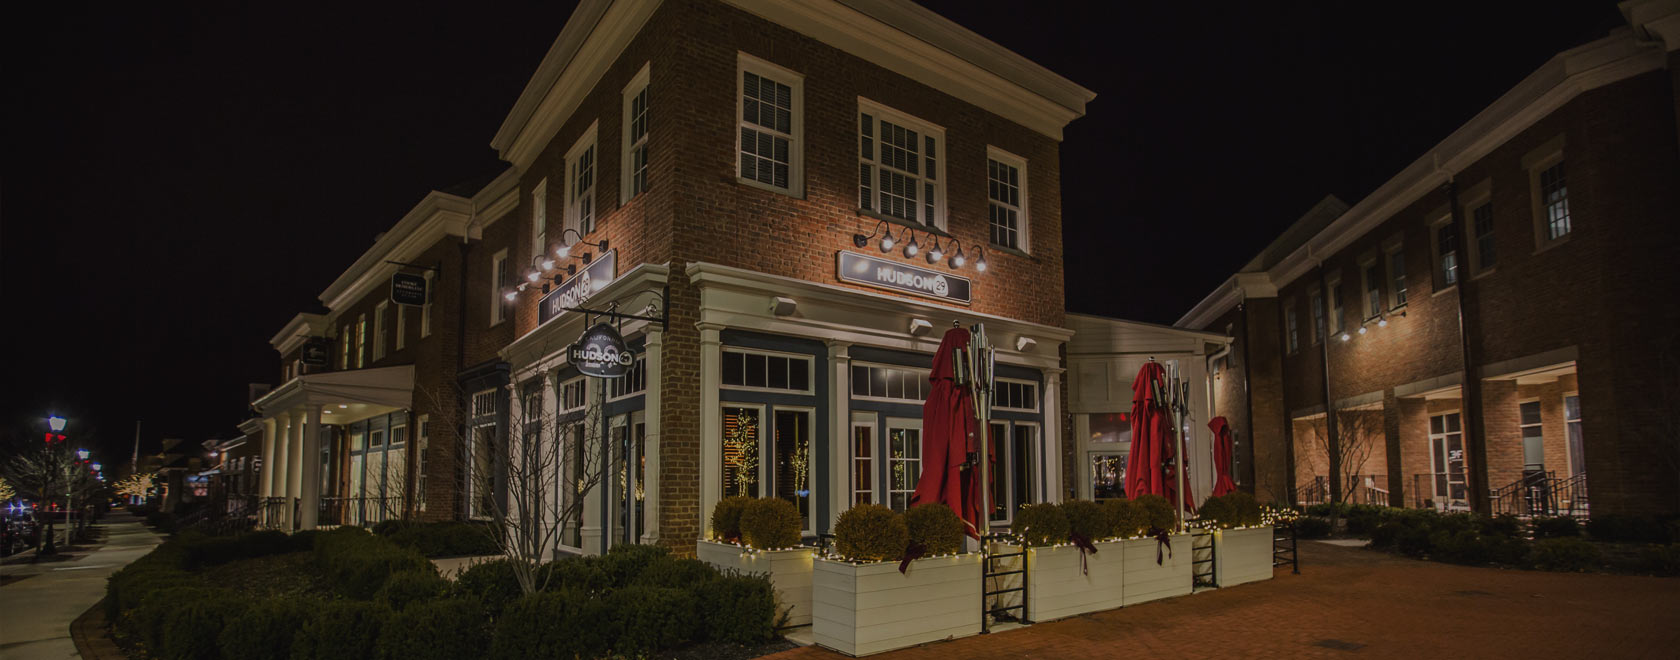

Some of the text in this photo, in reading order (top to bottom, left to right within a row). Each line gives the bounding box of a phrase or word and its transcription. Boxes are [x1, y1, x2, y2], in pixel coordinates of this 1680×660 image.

[877, 267, 946, 292] HUDSON 29
[552, 283, 581, 313] HUDSON
[573, 349, 619, 362] HUDSON
